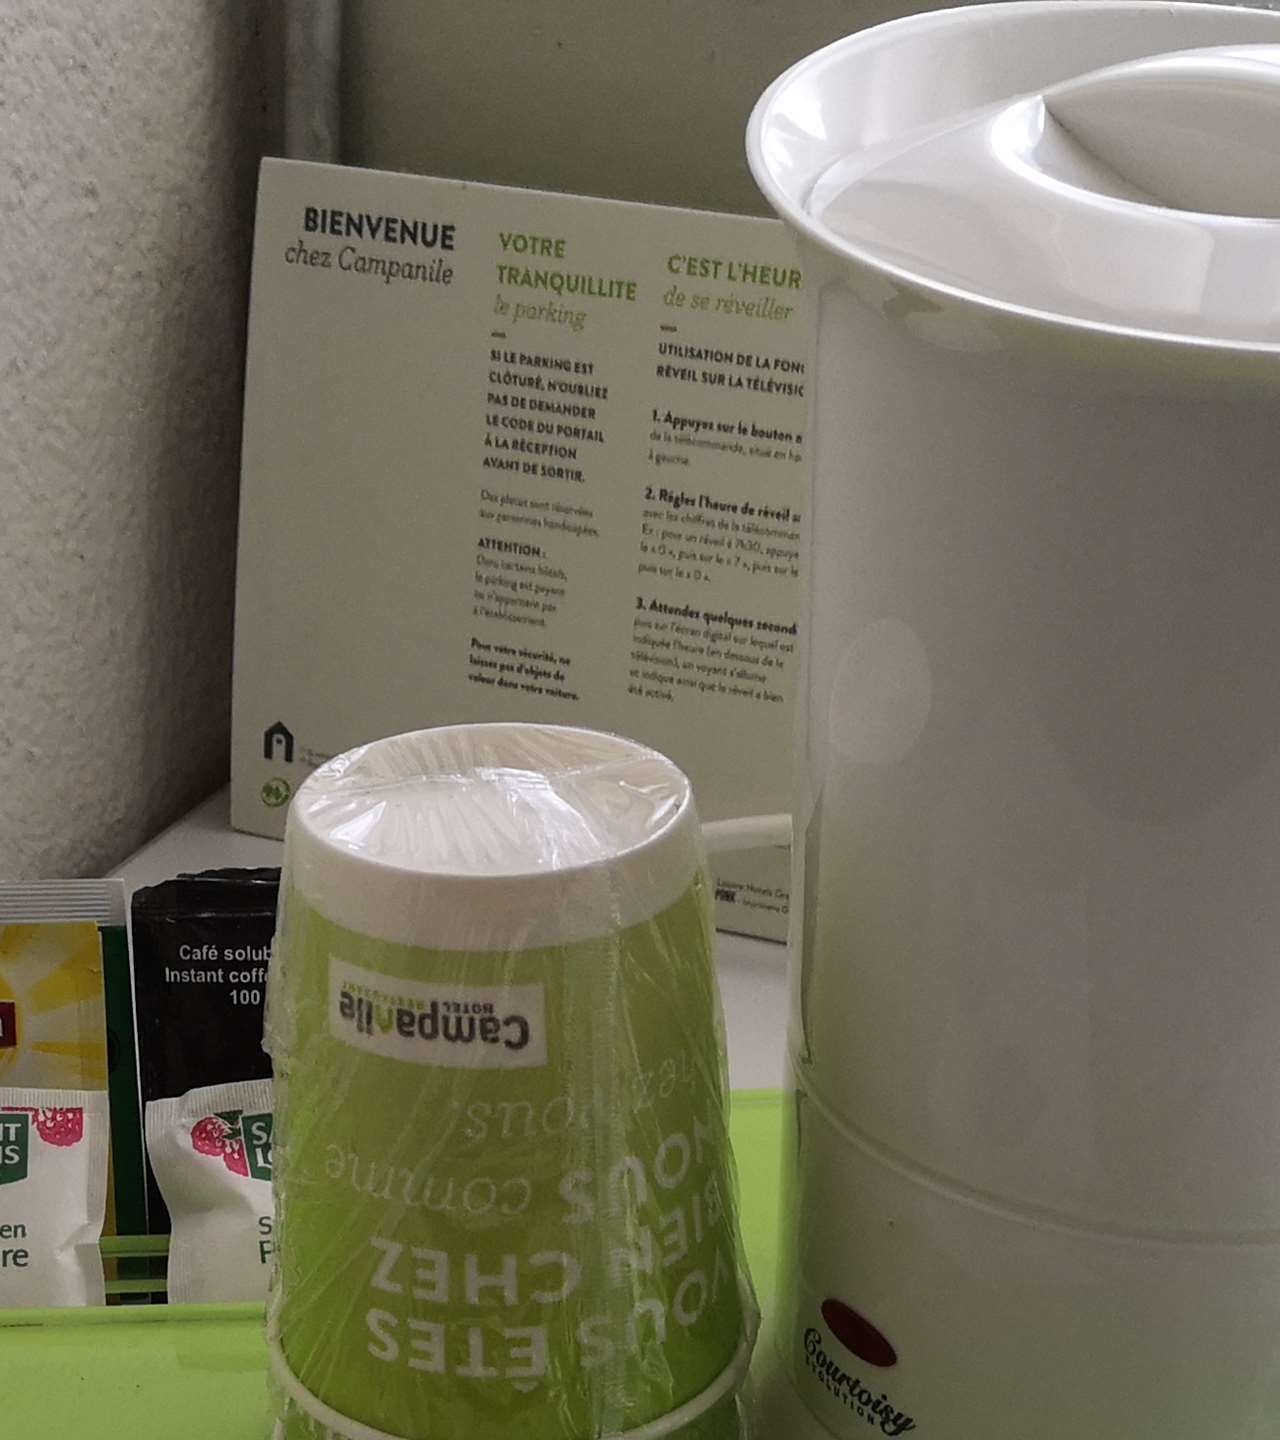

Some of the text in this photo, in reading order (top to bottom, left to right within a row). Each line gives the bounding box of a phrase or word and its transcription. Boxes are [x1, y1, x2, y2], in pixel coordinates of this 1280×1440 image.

[304, 206, 456, 251] BIENVENUE
[499, 232, 566, 258] VOTRE
[285, 240, 454, 286] chez Campanile
[667, 254, 802, 289] C'EST L'HEUR
[494, 294, 587, 333] le parking
[663, 285, 794, 320] de se réveiller
[490, 350, 594, 375] SI LE PARKING EST
[658, 343, 733, 365] UTILISATION
[737, 353, 752, 366] DE
[756, 358, 770, 370] LA
[656, 364, 697, 382] RÉVEIL
[702, 371, 725, 386] SUR
[729, 376, 743, 388] LA
[487, 393, 596, 419] PAS DE DEMANDER
[486, 415, 605, 443] LE CODE DU PORTAIL
[652, 409, 661, 422] 1.
[717, 422, 734, 433] sur
[738, 420, 748, 435] le
[751, 424, 792, 442] bouton
[495, 436, 509, 449] LA
[511, 438, 577, 460] RÉCEPTION
[483, 456, 585, 483] AVANT DE SORTIR.
[645, 486, 656, 500] 2.
[740, 501, 755, 516] de
[757, 506, 790, 521] réveil
[478, 537, 541, 557] ATTENTION
[635, 596, 647, 611] 3.
[703, 610, 754, 630] quelques
[756, 620, 797, 635] second
[179, 944, 271, 962] Café solub
[165, 967, 270, 984] Instant coff
[230, 990, 260, 1006] 100
[339, 990, 530, 1052] Campanile
[324, 1142, 531, 1220] comme
[0, 1222, 27, 1240] en
[368, 1235, 580, 1304] CHEZ
[365, 1307, 546, 1393] ÊTES
[804, 1328, 916, 1436] Courtoisy
